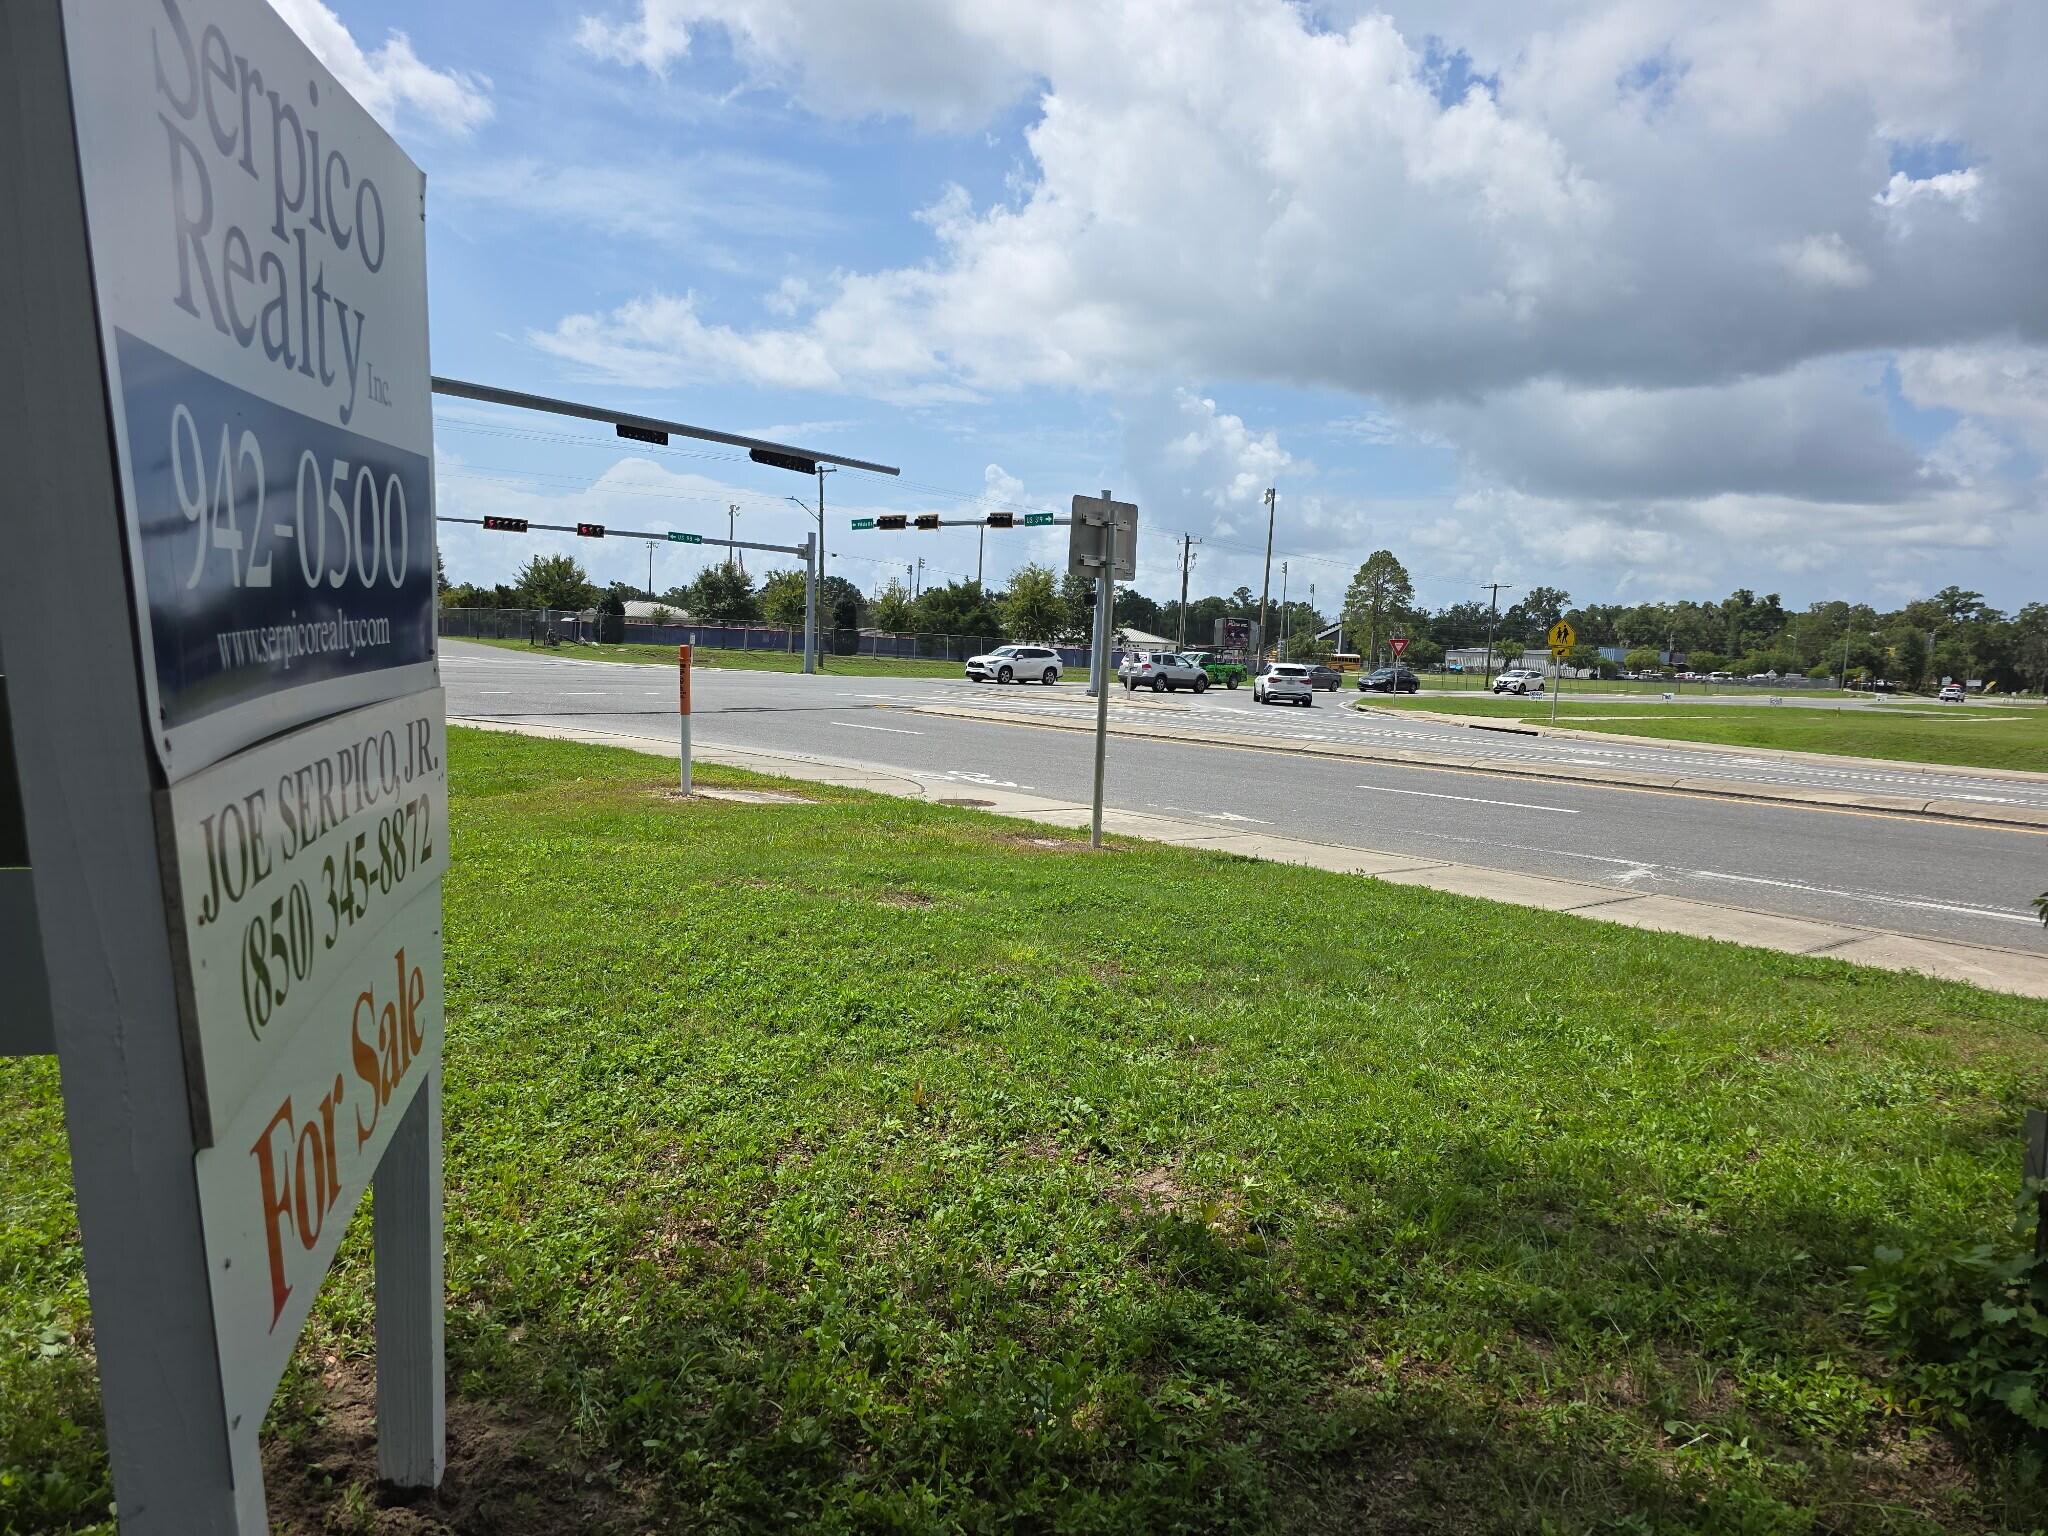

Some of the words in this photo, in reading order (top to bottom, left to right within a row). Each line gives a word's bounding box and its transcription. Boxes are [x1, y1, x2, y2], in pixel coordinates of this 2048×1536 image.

[152, 0, 386, 274] Serpico
[158, 111, 366, 426] Realty
[366, 361, 393, 409] Inc.
[171, 403, 409, 590] 942-0500
[216, 608, 391, 670] www.serpicorealty.com
[200, 788, 273, 924] JOE
[277, 729, 401, 862] SERPICO,
[404, 717, 440, 784] JR.
[242, 879, 315, 1042] (850)
[321, 793, 433, 951] 345-8872
[250, 1073, 344, 1335] For
[352, 946, 426, 1156] Sale
